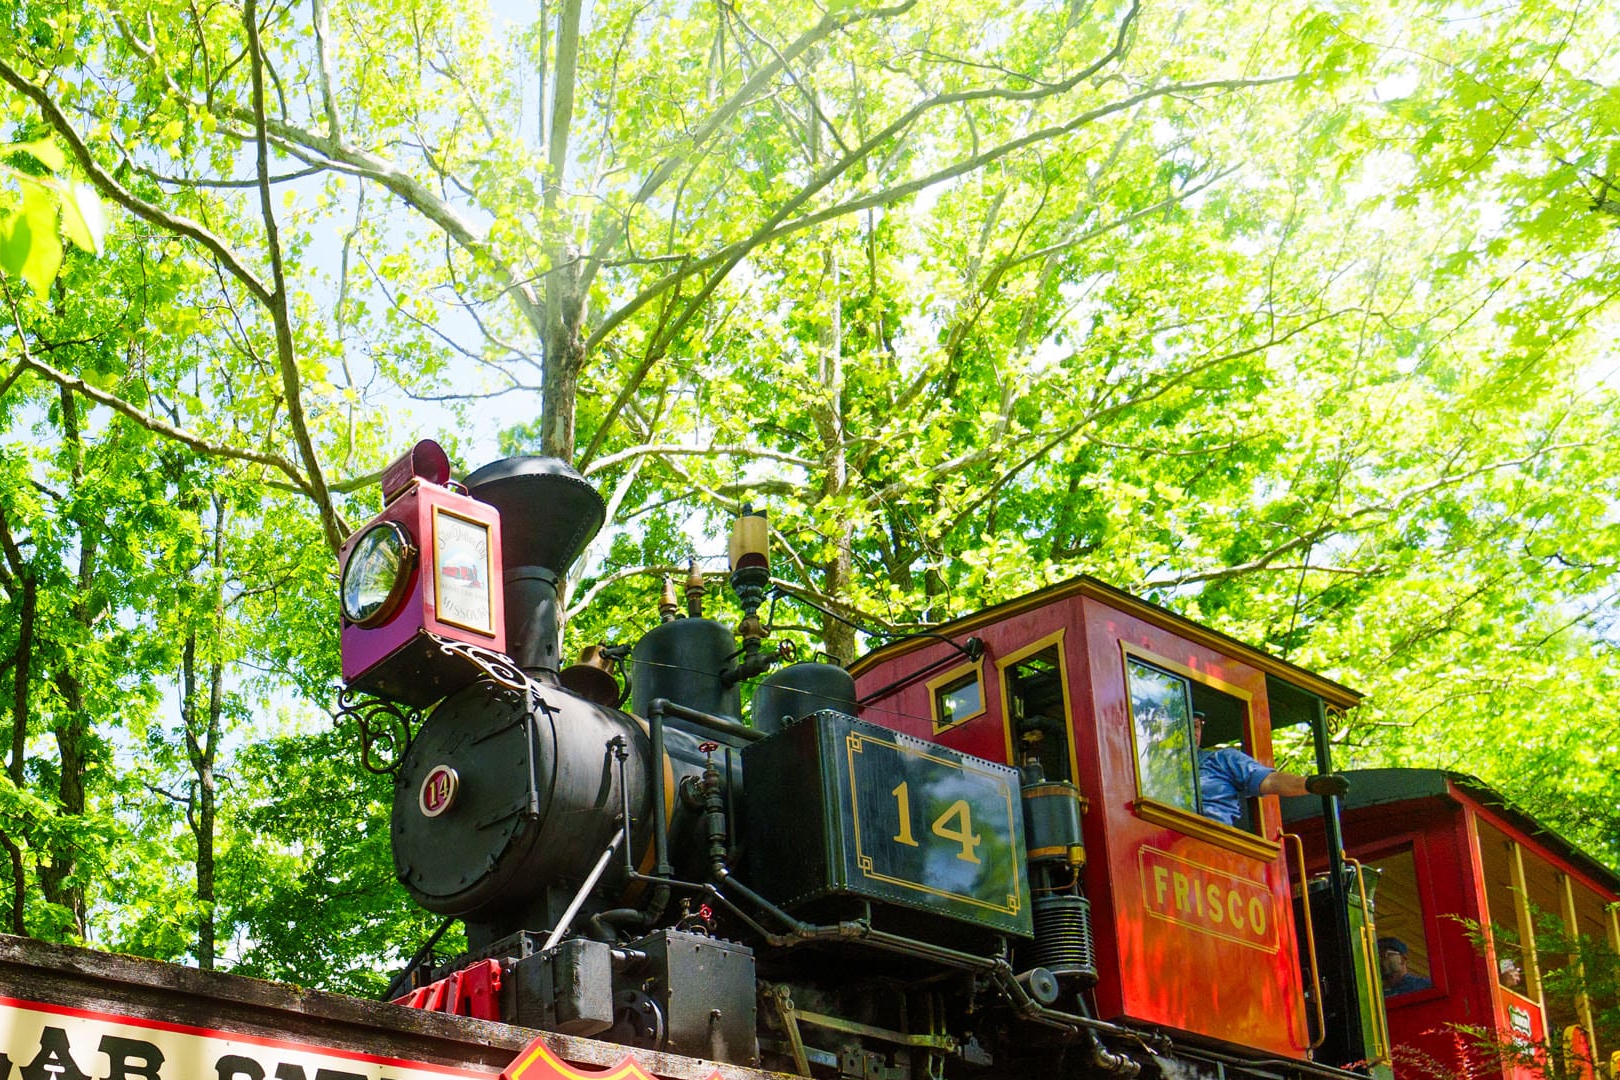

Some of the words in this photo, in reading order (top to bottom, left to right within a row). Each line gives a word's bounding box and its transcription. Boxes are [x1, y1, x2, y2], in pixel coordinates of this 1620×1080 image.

[430, 774, 449, 807] 14
[891, 781, 981, 865] 14
[1153, 865, 1267, 937] FRISCO
